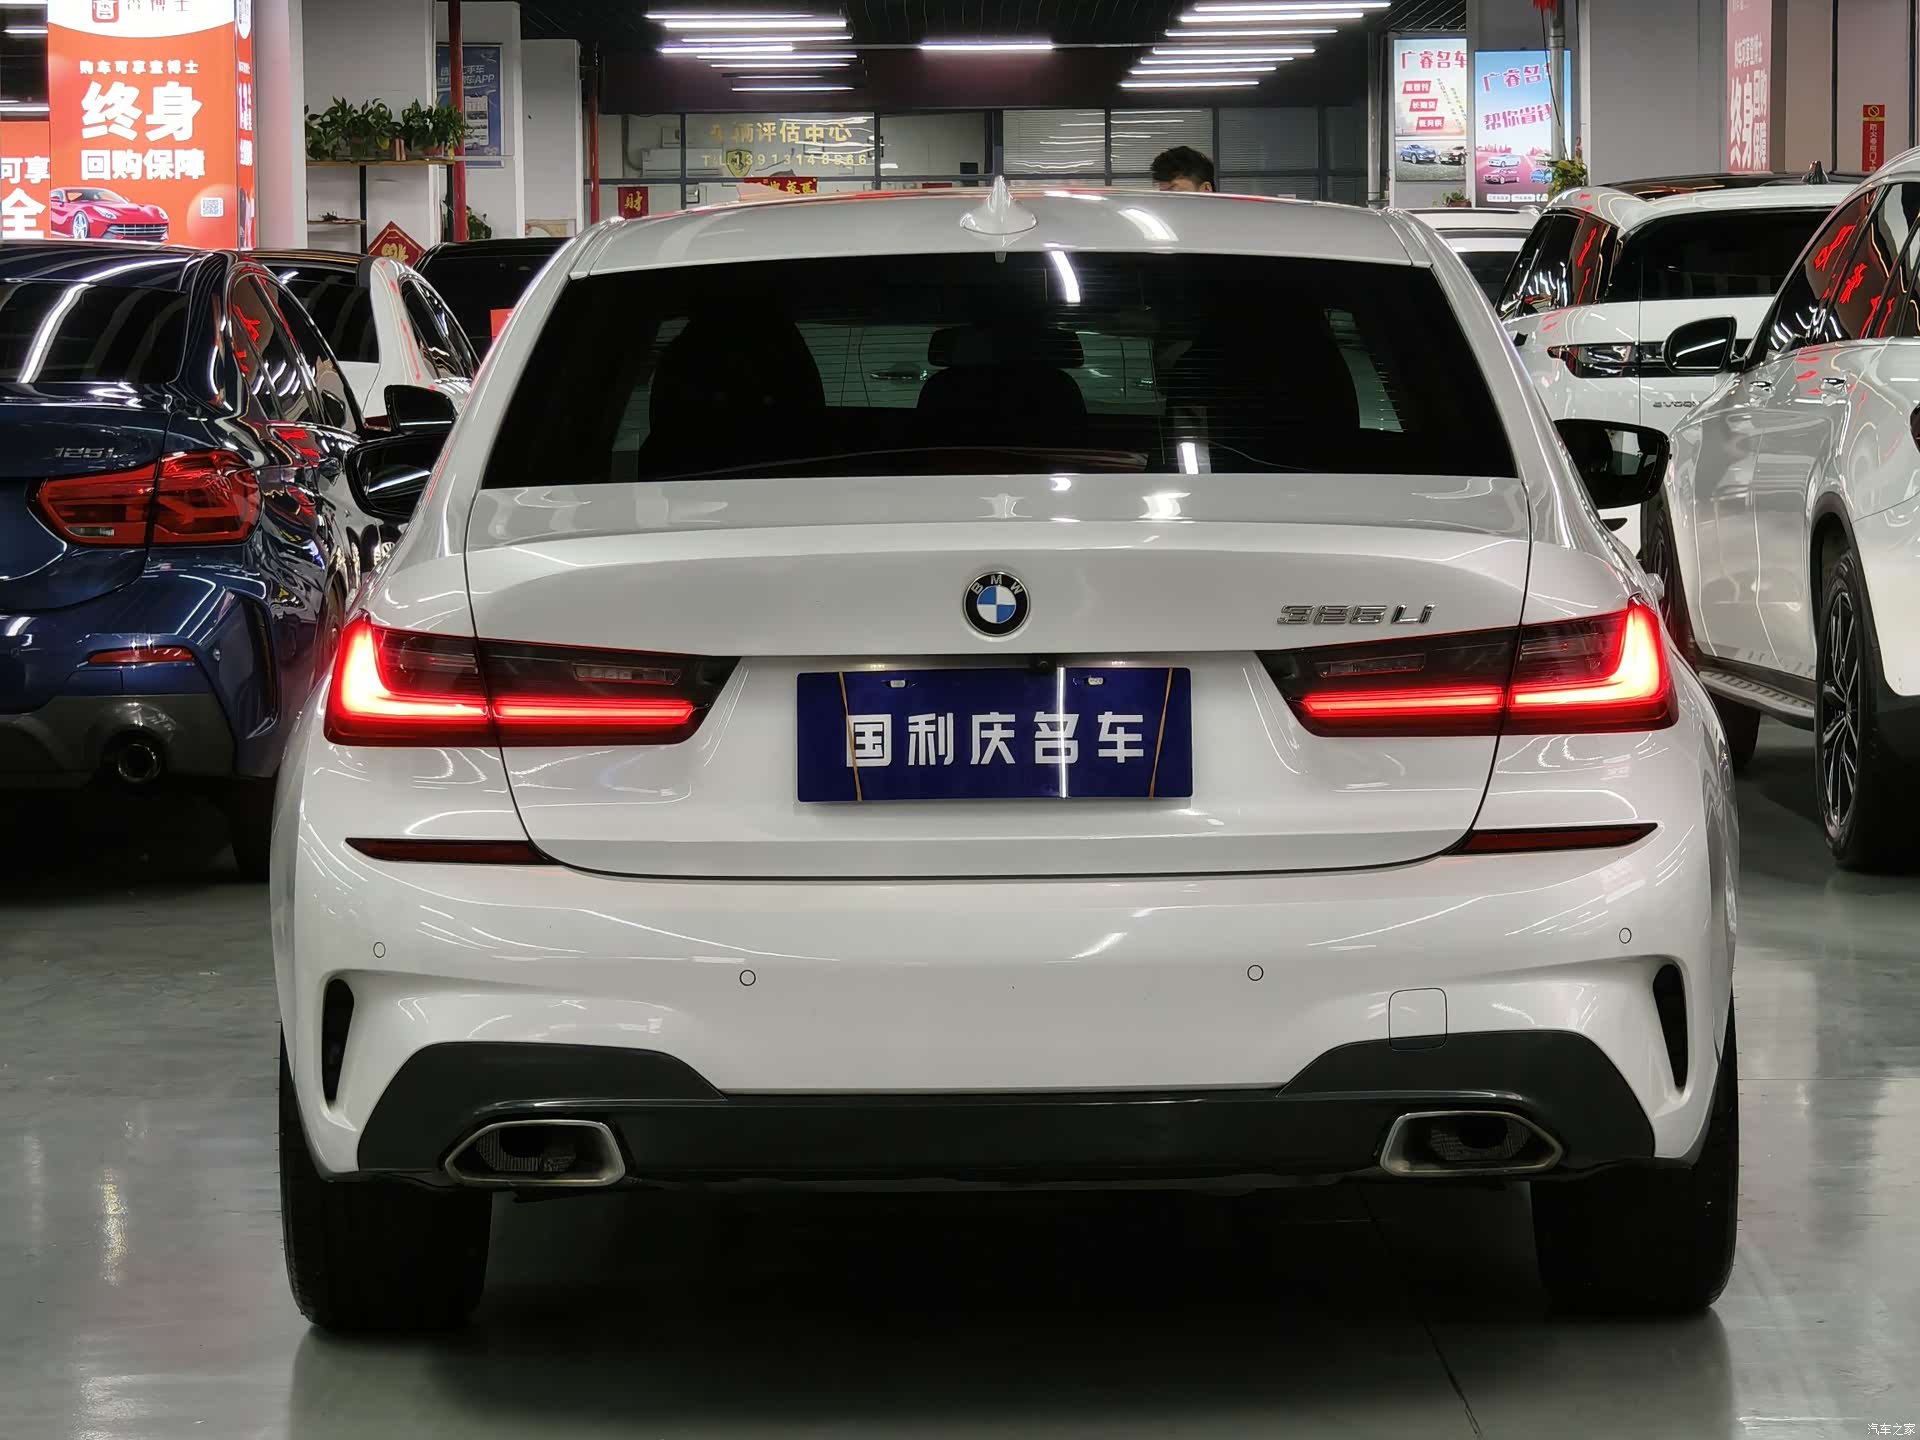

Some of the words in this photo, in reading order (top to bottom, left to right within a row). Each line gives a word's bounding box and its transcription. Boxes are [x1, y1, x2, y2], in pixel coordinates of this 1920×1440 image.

[81, 80, 203, 142] 终身
[0, 156, 50, 184] 可享
[81, 148, 205, 180] 回购保障
[970, 574, 1023, 595] BMW
[846, 711, 1144, 768] 国利庆名车
